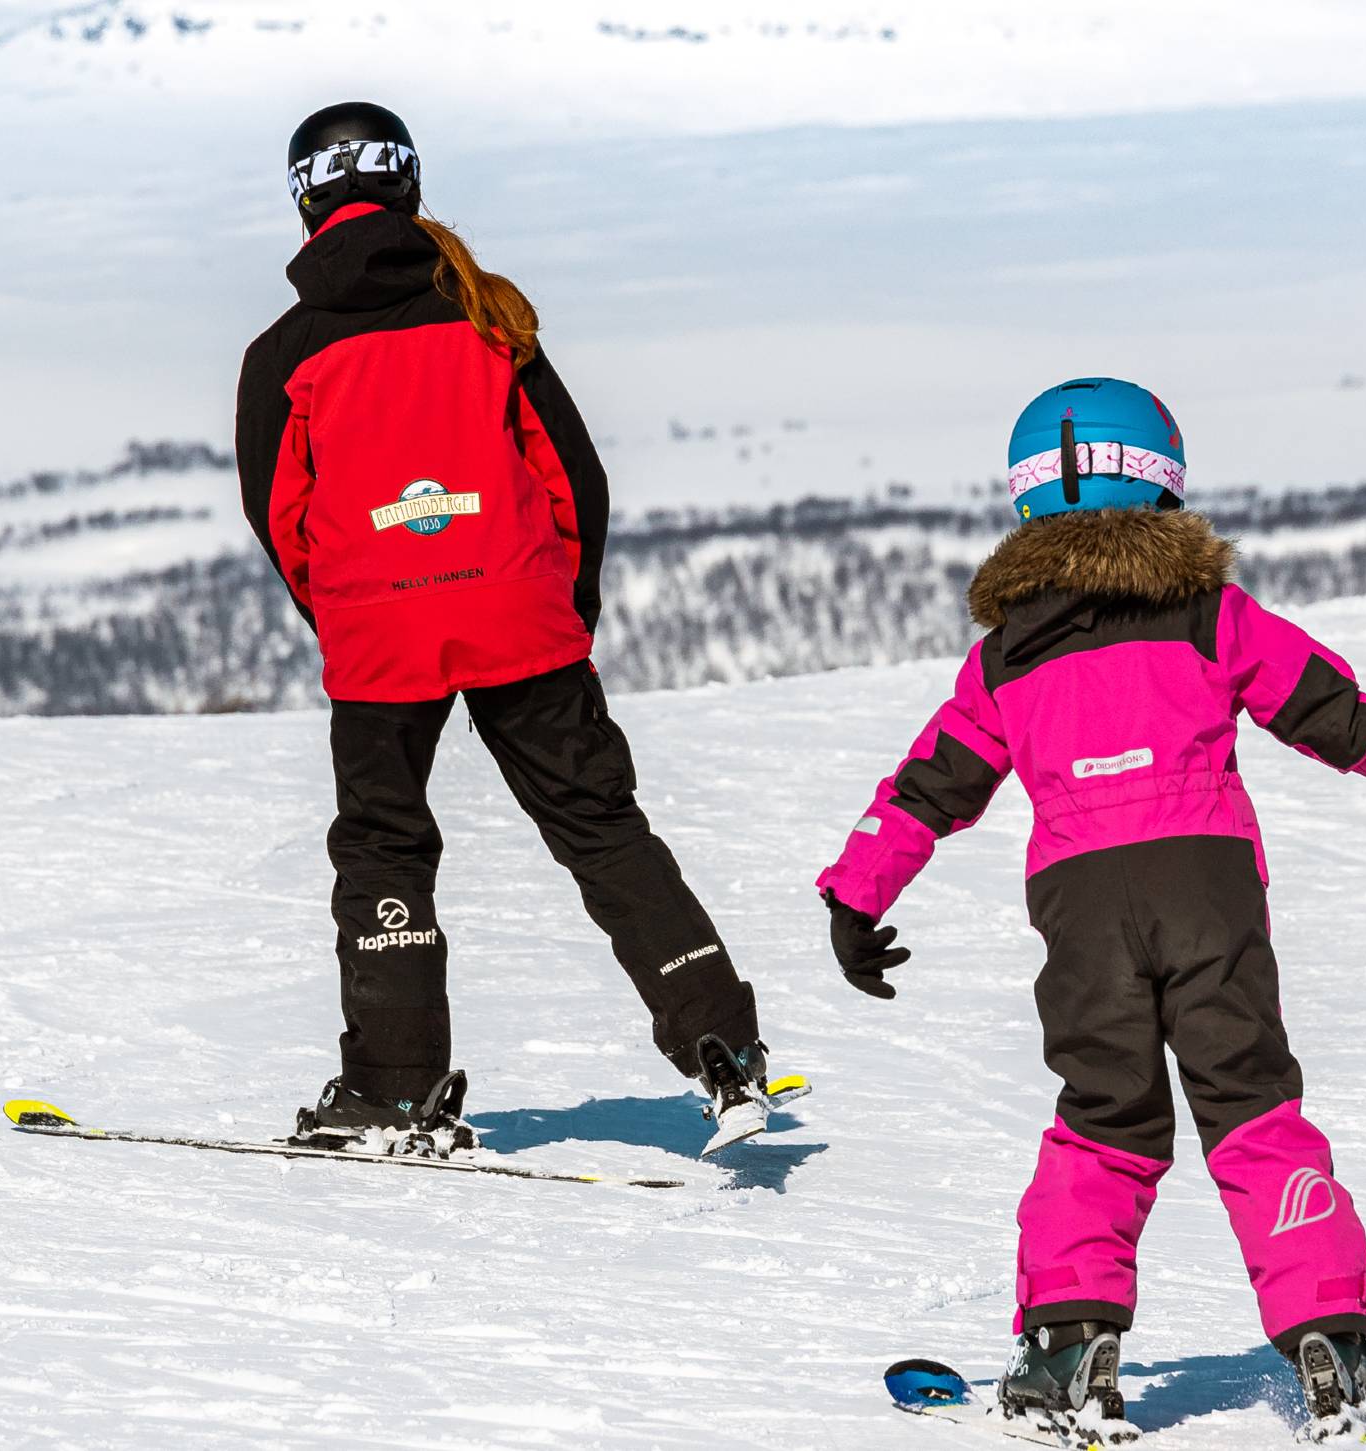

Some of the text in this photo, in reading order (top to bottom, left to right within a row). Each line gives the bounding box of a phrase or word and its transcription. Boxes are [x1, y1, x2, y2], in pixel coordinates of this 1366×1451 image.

[376, 495, 476, 526] RAMUNDBERGET
[391, 567, 484, 591] HELLY HANSEN
[356, 928, 438, 951] topsport
[659, 944, 719, 976] HELLY HANSEN
